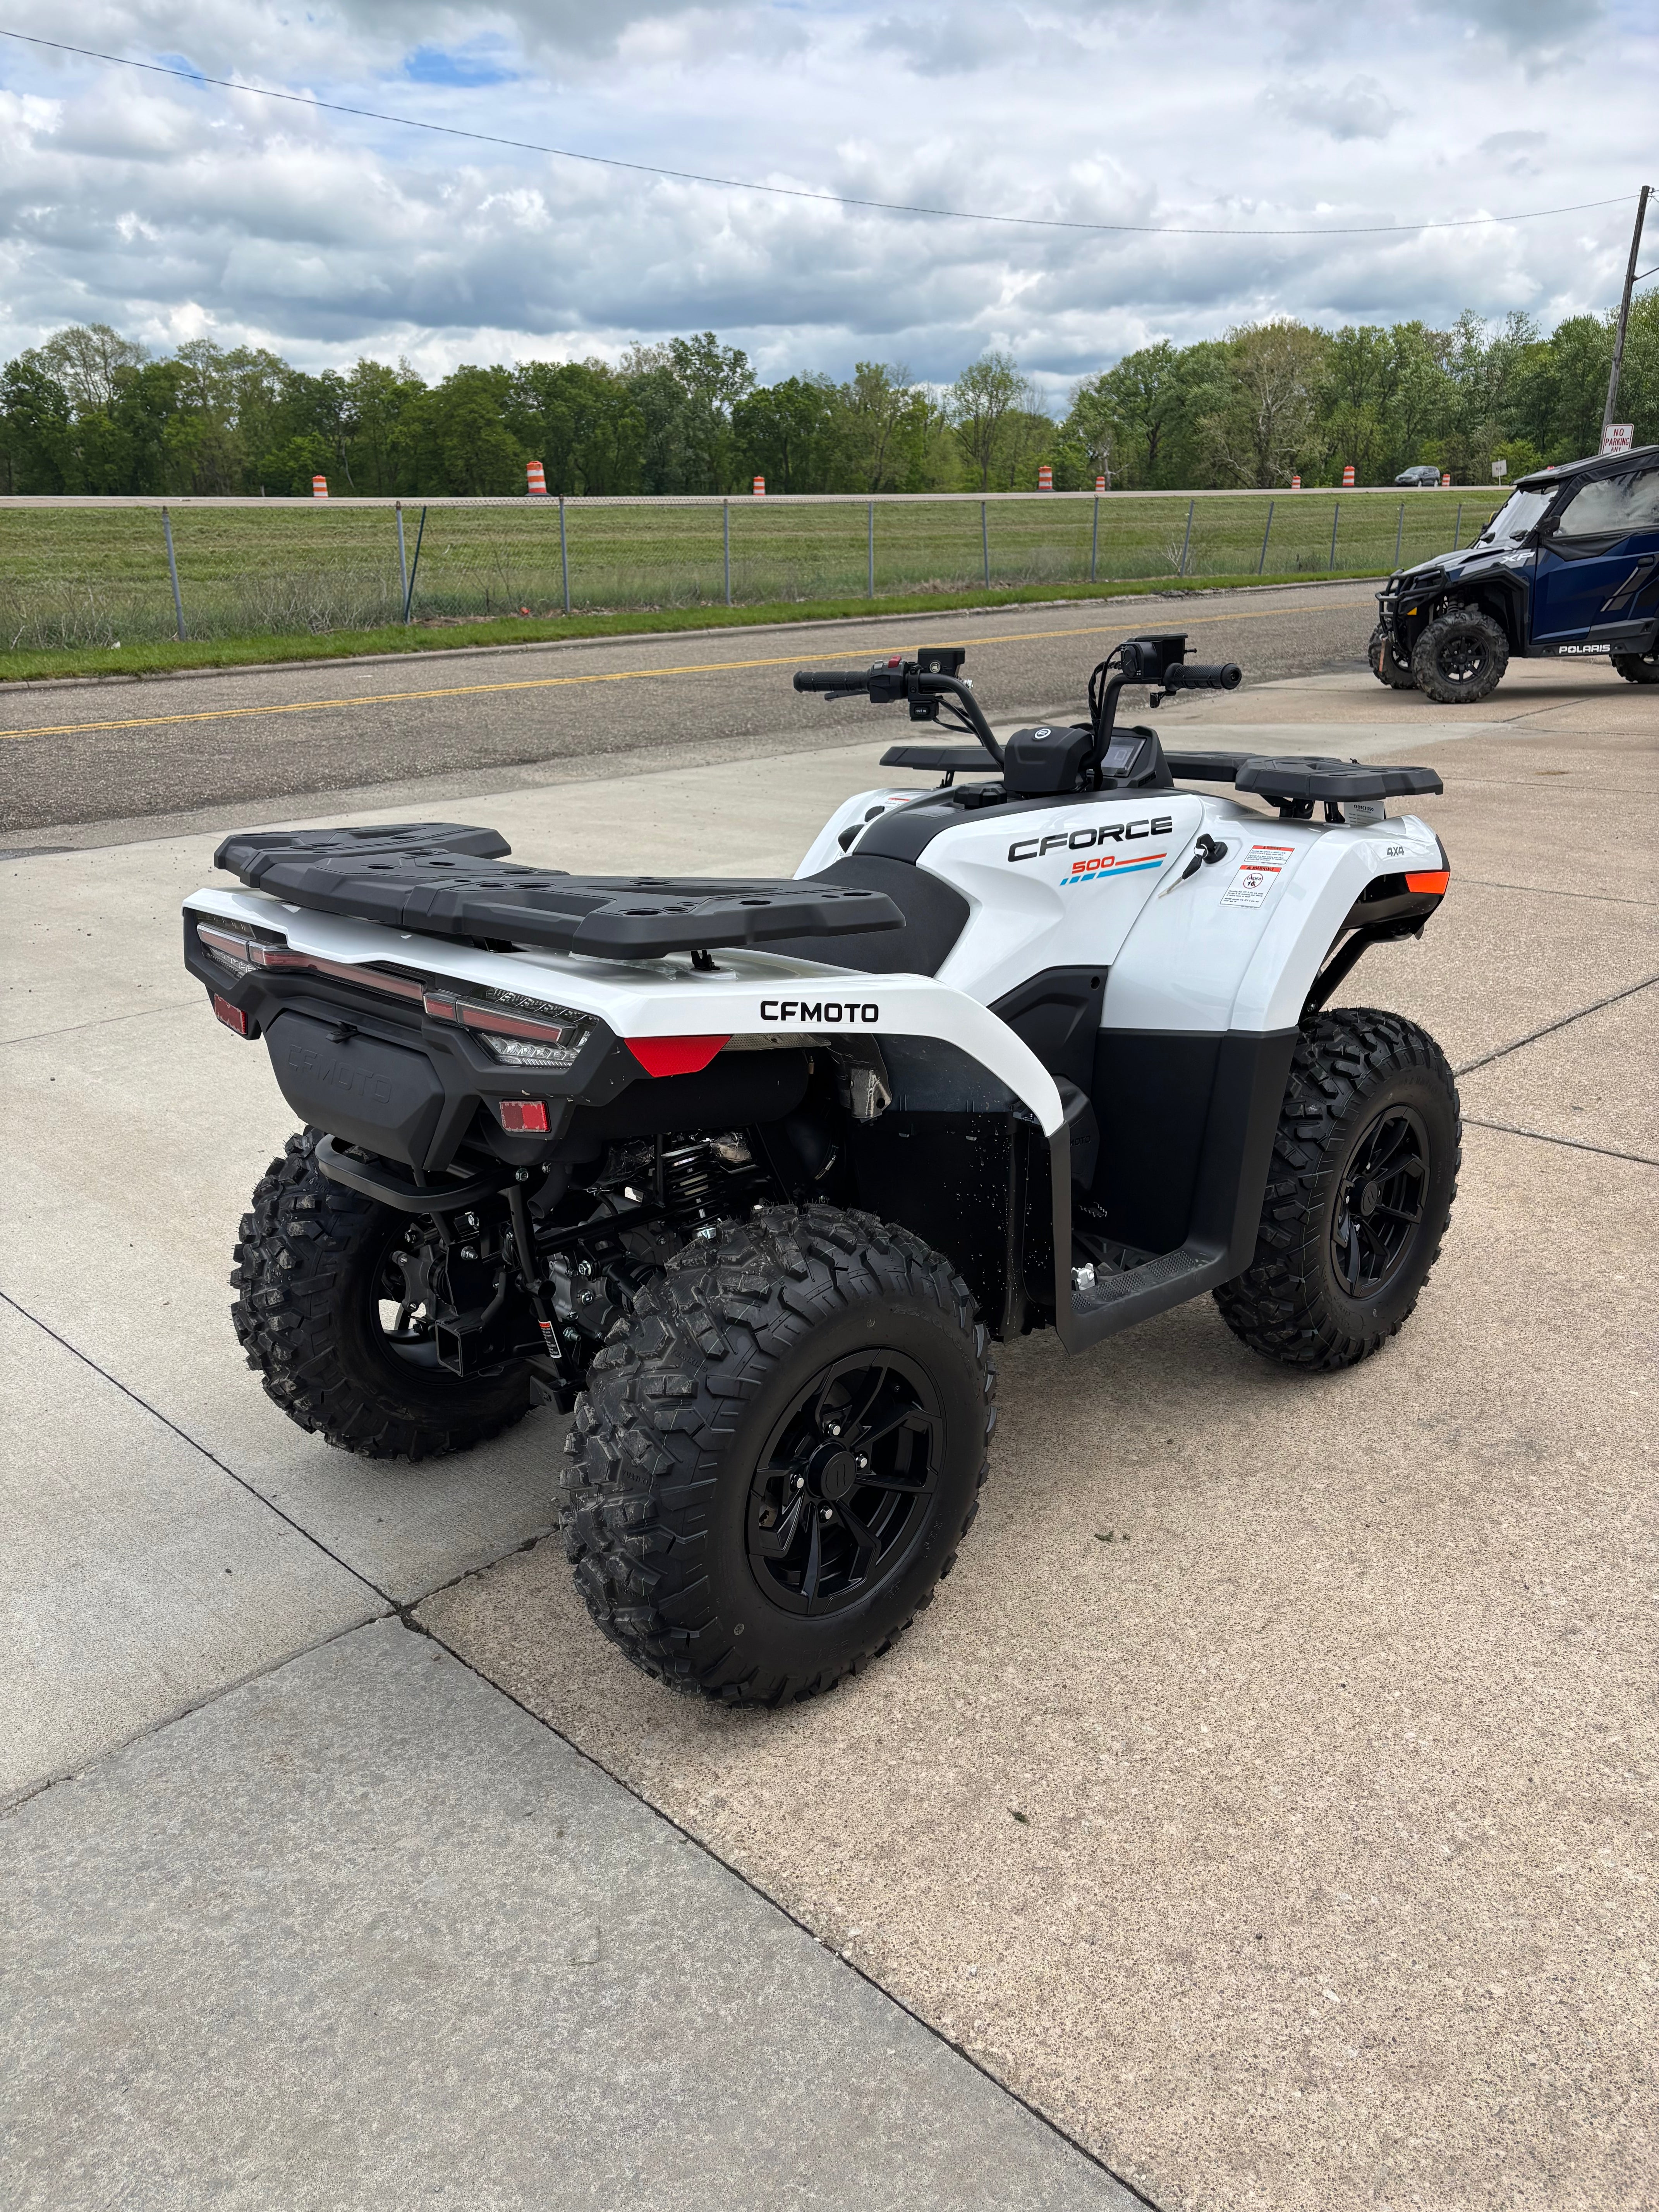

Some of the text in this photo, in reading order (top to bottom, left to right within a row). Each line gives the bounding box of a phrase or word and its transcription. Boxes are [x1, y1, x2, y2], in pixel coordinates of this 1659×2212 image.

[1613, 428, 1624, 436] NO
[1605, 437, 1630, 446] PARKING
[1499, 551, 1535, 564] XP
[1559, 644, 1611, 654] POLARIS
[1007, 816, 1173, 862] CFORCE
[1072, 856, 1115, 874] 500
[760, 1000, 879, 1023] CFMOTO
[288, 1044, 392, 1104] CFMOTO
